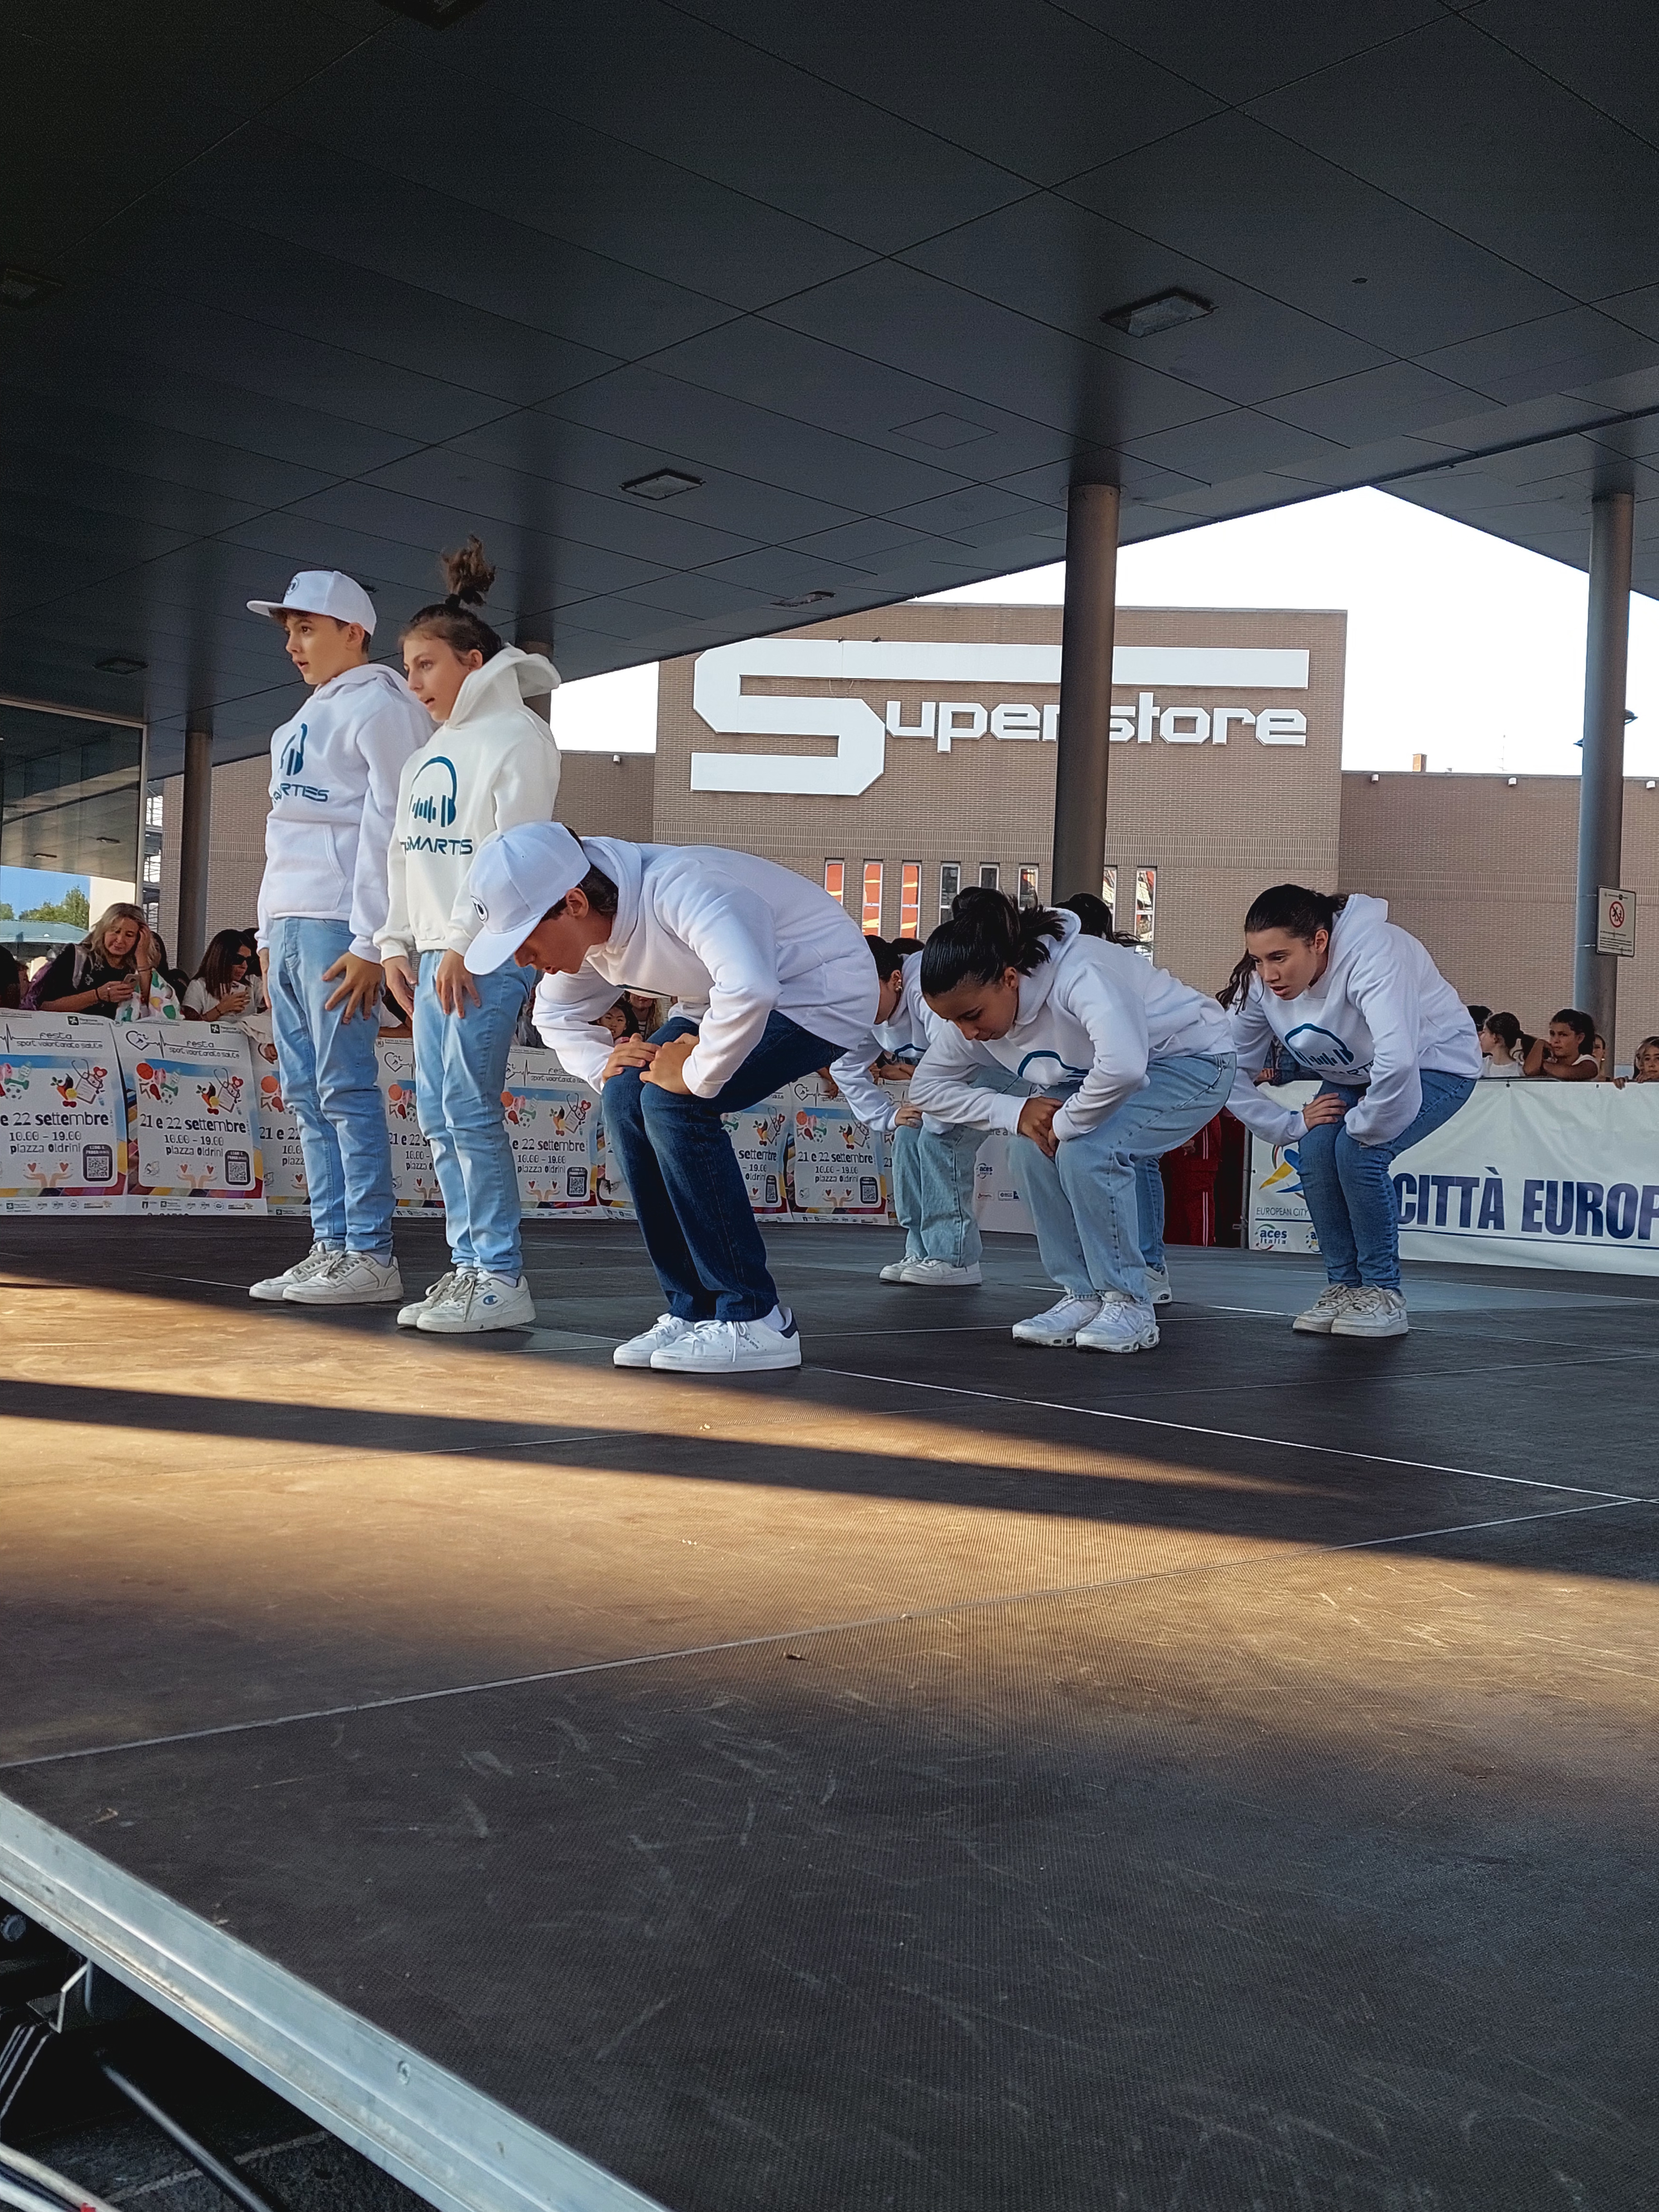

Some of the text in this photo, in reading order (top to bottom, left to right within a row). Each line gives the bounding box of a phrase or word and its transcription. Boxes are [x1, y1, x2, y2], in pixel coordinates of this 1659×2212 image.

[691, 638, 1310, 795] Superstore
[0, 1115, 9, 1126] e
[13, 1112, 31, 1126] 22
[35, 1112, 109, 1126] settembre
[140, 1114, 246, 1133] 21 e 22 settembre
[10, 1131, 39, 1141] 10.00
[52, 1131, 81, 1141] 19.00
[259, 1127, 273, 1139] 21
[276, 1129, 284, 1140] e
[164, 1134, 189, 1144] 10.00
[200, 1136, 224, 1146] 19.00
[388, 1132, 398, 1145] 21
[401, 1135, 407, 1145] e
[409, 1133, 420, 1146] 22
[10, 1143, 44, 1154] piazza
[48, 1143, 80, 1152] Oldrini
[282, 1145, 303, 1154] 10.0
[512, 1139, 585, 1151] e 22 settembre
[166, 1146, 194, 1156] piazza
[282, 1157, 305, 1166] piazz
[518, 1155, 539, 1163] 10.00
[797, 1151, 873, 1163] 21 e 22 settembre
[406, 1161, 427, 1171] piazza
[518, 1165, 542, 1173] piazza
[815, 1175, 837, 1183] piazza
[1393, 1166, 1659, 1240] CITTÀ EUROP
[1256, 1207, 1309, 1217] EUROPEAN CITY
[1260, 1229, 1288, 1239] aces
